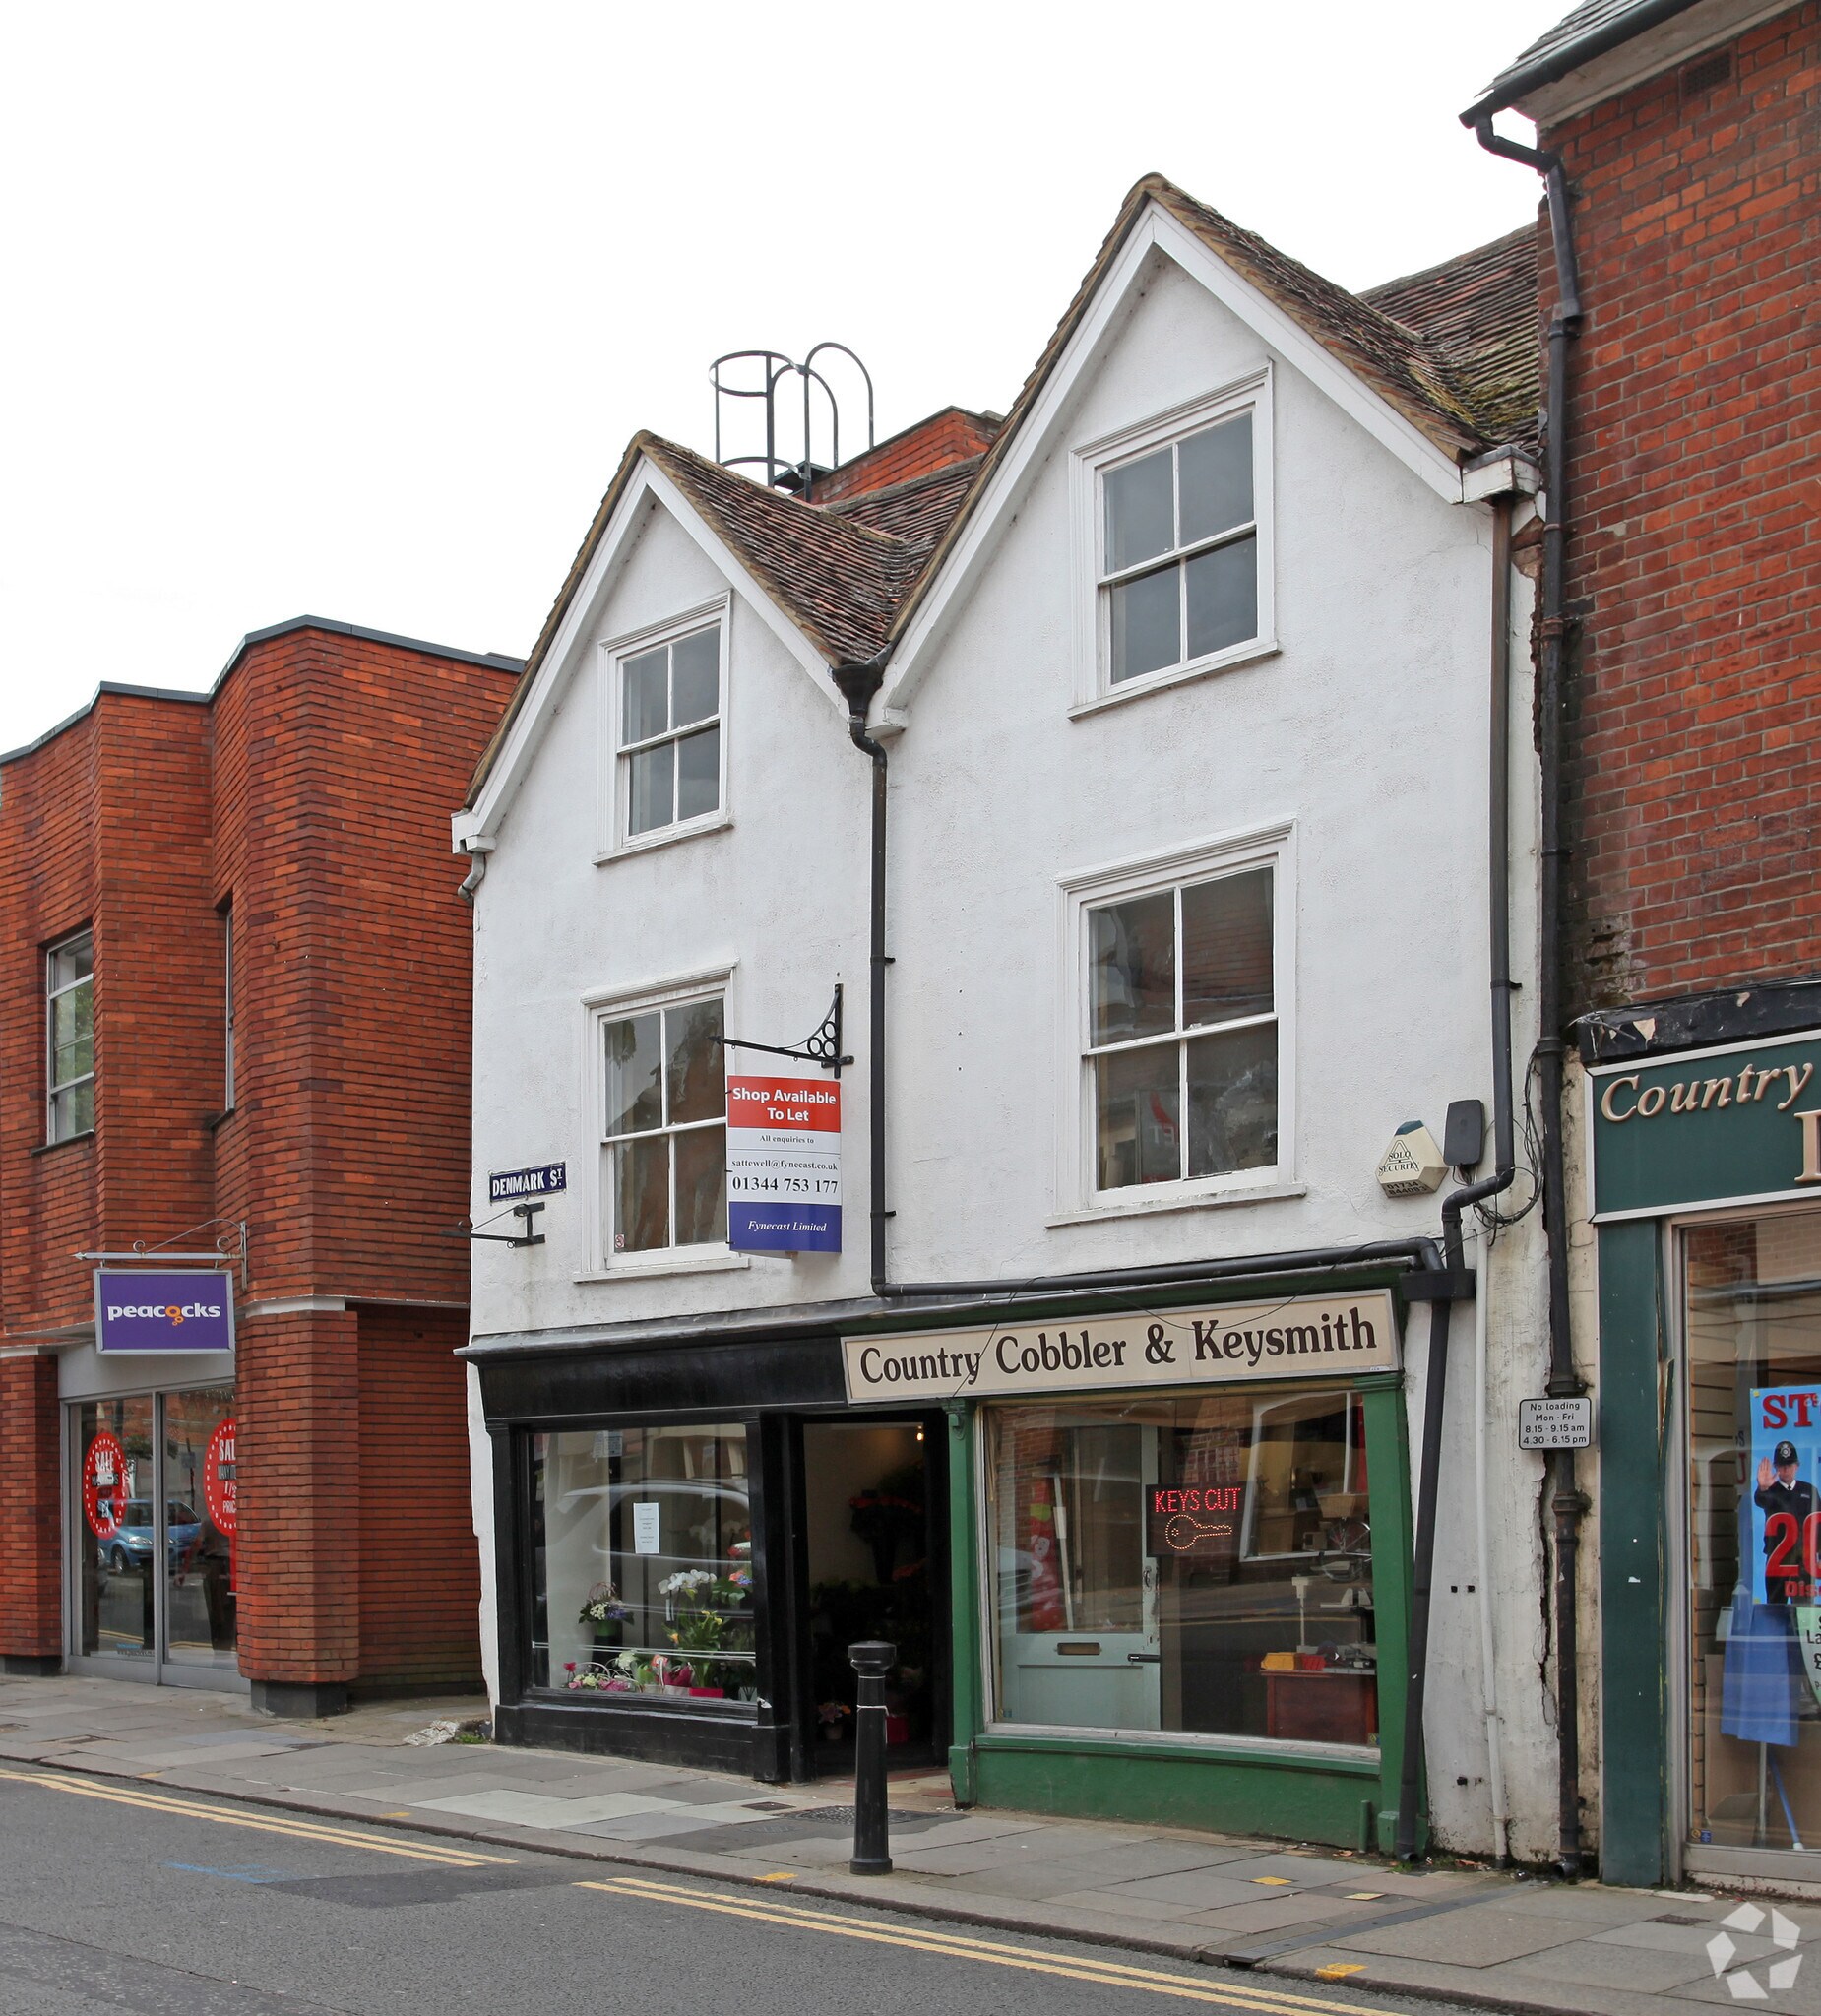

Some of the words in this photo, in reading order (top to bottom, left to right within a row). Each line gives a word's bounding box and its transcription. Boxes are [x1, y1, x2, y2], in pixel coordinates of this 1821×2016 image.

[732, 1087, 770, 1103] Shop
[773, 1089, 837, 1105] Available
[1601, 1062, 1814, 1122] Country
[767, 1107, 785, 1120] To
[787, 1108, 809, 1122] Let
[773, 1135, 806, 1145] enquiries
[1388, 1151, 1411, 1160] SOLO
[731, 1159, 838, 1171] sattewell@fynecast.co.uk
[1378, 1162, 1419, 1172] SECURITY
[492, 1171, 545, 1197] DENMARK
[732, 1176, 779, 1191] 01344
[784, 1178, 809, 1192] 753
[815, 1180, 838, 1194] 177
[747, 1220, 790, 1231] Fynecast
[792, 1221, 827, 1232] Limited
[107, 1302, 221, 1322] peacocks
[860, 1347, 980, 1385] Country
[996, 1331, 1127, 1374] Cobbler
[1145, 1323, 1176, 1364] &
[1191, 1306, 1377, 1367] Keysmith
[1546, 1402, 1580, 1411] loading
[1763, 1393, 1821, 1429] ST
[1525, 1424, 1543, 1433] 8.15
[1551, 1435, 1570, 1444] 6.15
[219, 1439, 236, 1462] SAL
[95, 1451, 114, 1473] SALE
[222, 1500, 236, 1513] PRIC
[1155, 1489, 1200, 1513] KEYS
[1205, 1487, 1241, 1511] CUT
[1785, 1580, 1821, 1598] Dis
